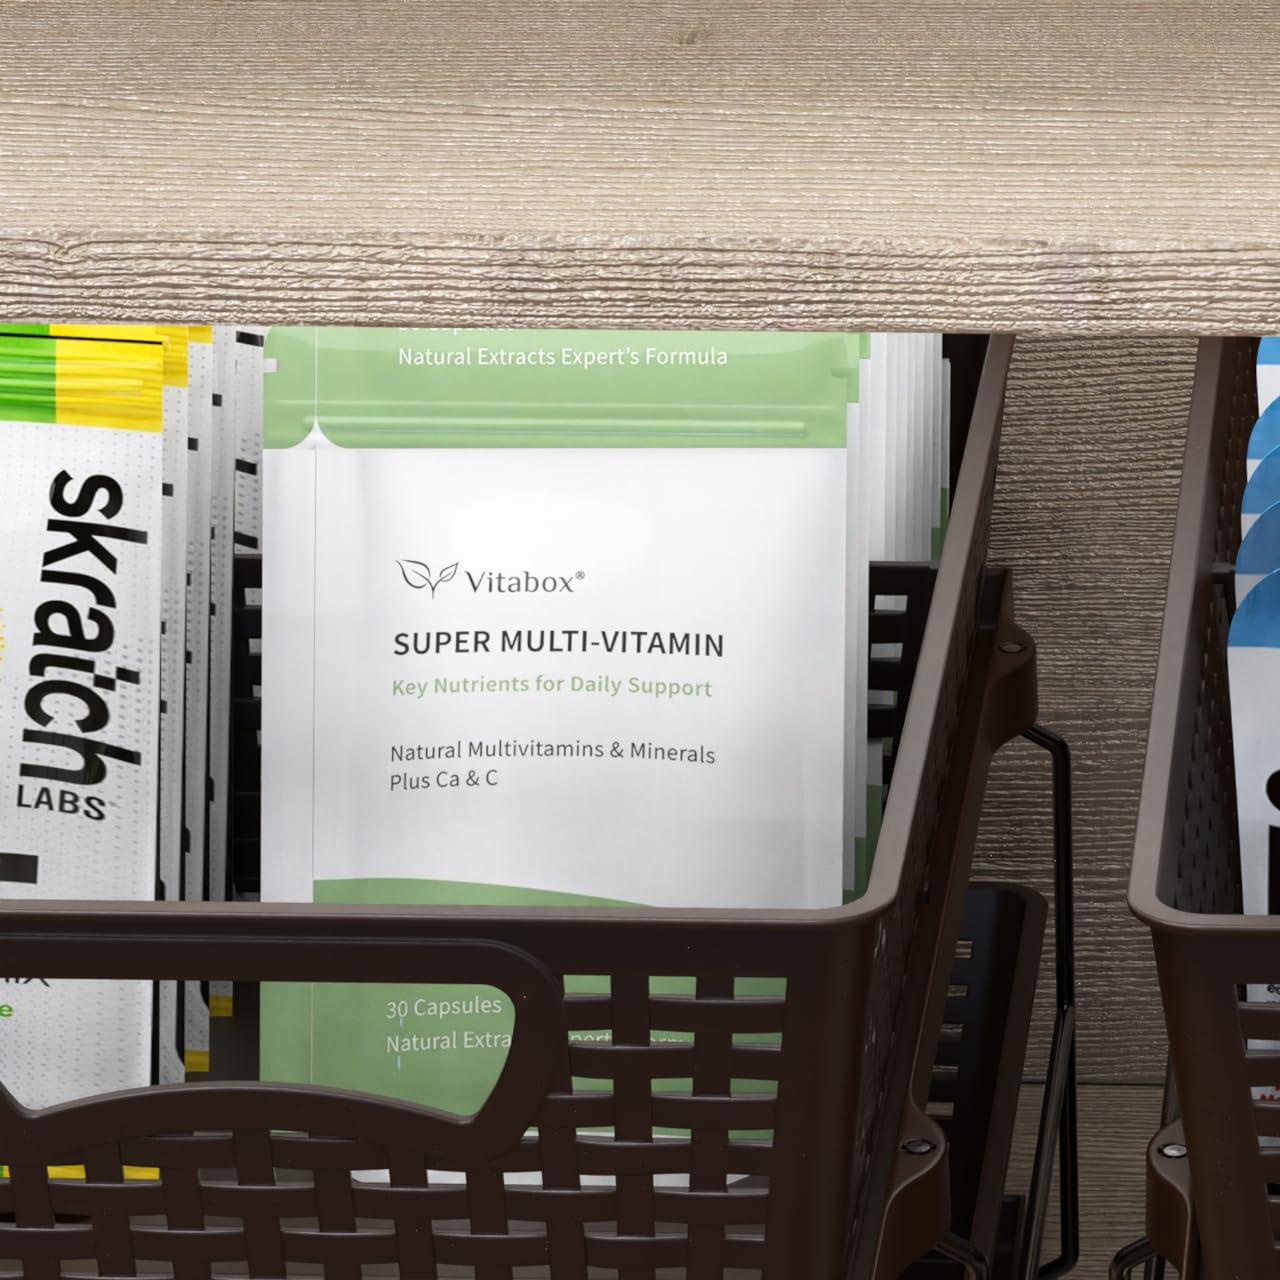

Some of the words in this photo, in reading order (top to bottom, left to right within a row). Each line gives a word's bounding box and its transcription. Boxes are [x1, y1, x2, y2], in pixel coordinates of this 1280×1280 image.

[399, 347, 471, 366] Natural
[477, 347, 555, 366] Extracts
[645, 347, 728, 366] Formula
[393, 630, 491, 656] SUPER
[501, 629, 724, 657] MULTI-VITAMIN
[392, 679, 428, 699] Key
[434, 675, 530, 695] Nutrients
[536, 674, 565, 693] for
[571, 675, 622, 697] Daily
[628, 677, 713, 699] Support
[390, 740, 462, 762] Natural
[468, 739, 604, 759] Multivitamins
[609, 741, 625, 758] &
[630, 742, 716, 764] Minerals
[390, 771, 431, 791] Plus
[436, 770, 460, 787] Ca
[465, 770, 480, 786] &
[485, 769, 498, 786] C
[17, 784, 106, 821] LABS
[386, 1000, 408, 1019] 30
[414, 995, 503, 1020] Capsules
[386, 1032, 458, 1053] Natural
